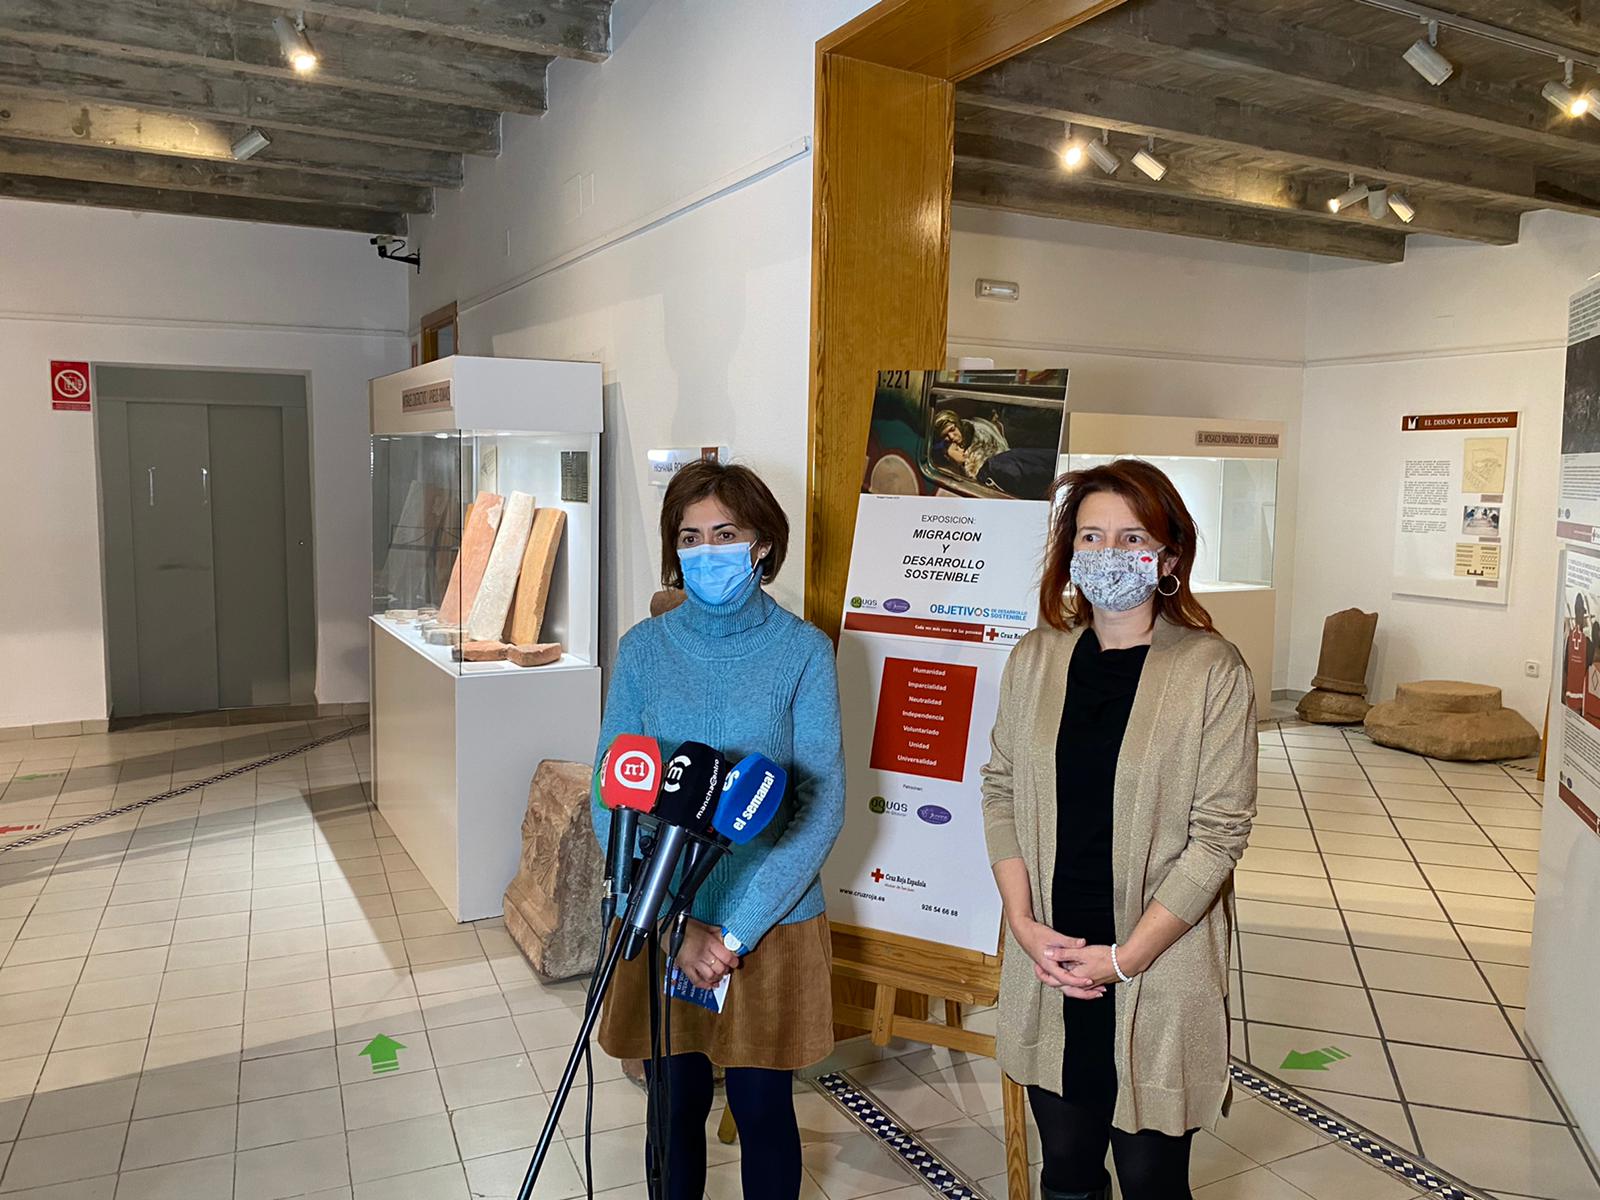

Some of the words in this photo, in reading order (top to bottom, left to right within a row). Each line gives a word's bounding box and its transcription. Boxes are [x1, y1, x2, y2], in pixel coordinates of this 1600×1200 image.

[921, 514, 976, 524] EXPOSICION:
[912, 529, 982, 542] MIGRACION
[942, 544, 950, 553] Y
[902, 555, 984, 570] DESARROLLO
[904, 569, 980, 583] SOSTENIBLE
[930, 604, 990, 618] OBJETIVOS
[1000, 631, 1013, 640] Cruz
[913, 667, 946, 676] Humanidad
[908, 681, 947, 692] Imparcialidad
[908, 696, 942, 706] Neutralidad
[902, 710, 945, 721] Independencia
[903, 725, 940, 736] Voluntariado
[908, 741, 930, 750] Unidad
[897, 754, 937, 766] Universalidad
[732, 817, 747, 831] el
[742, 771, 776, 821] semanal
[885, 873, 896, 882] Cruz
[896, 876, 907, 884] Roja
[839, 887, 886, 902] www.cruzroja.es
[921, 903, 932, 912] 926
